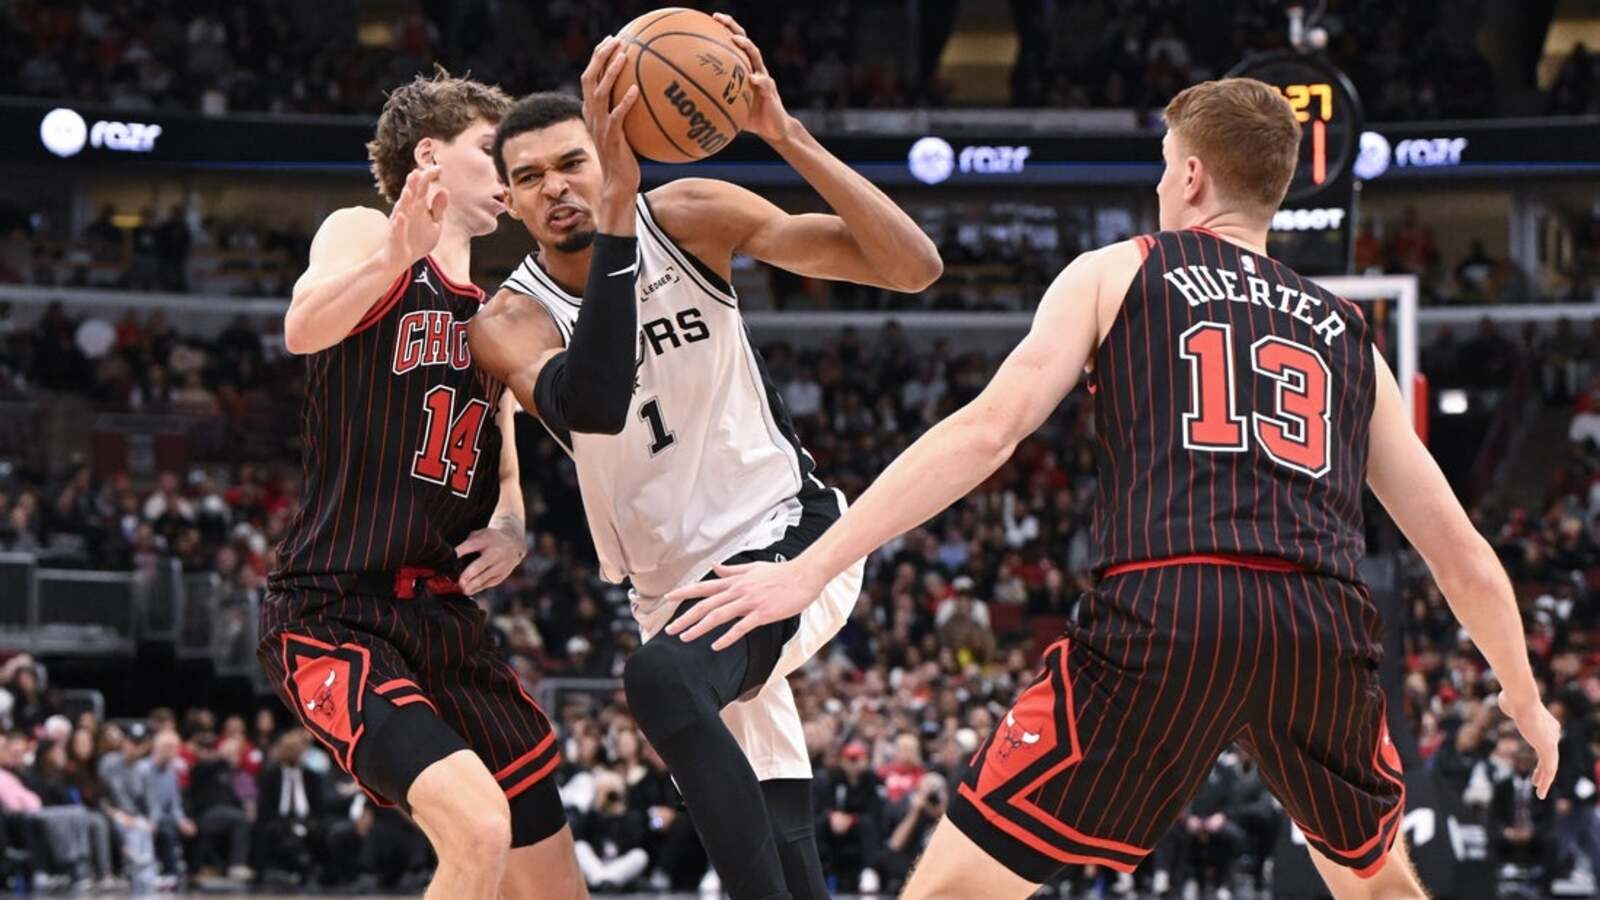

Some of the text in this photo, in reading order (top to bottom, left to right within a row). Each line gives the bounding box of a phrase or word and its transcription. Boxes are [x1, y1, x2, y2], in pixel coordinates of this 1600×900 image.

[664, 80, 729, 154] Wilson
[642, 273, 673, 295] LEDGER
[1163, 265, 1346, 346] HUERTER
[636, 308, 710, 367] RS
[637, 395, 678, 460] 1
[1179, 320, 1333, 479] 13
[410, 385, 490, 498] 14
